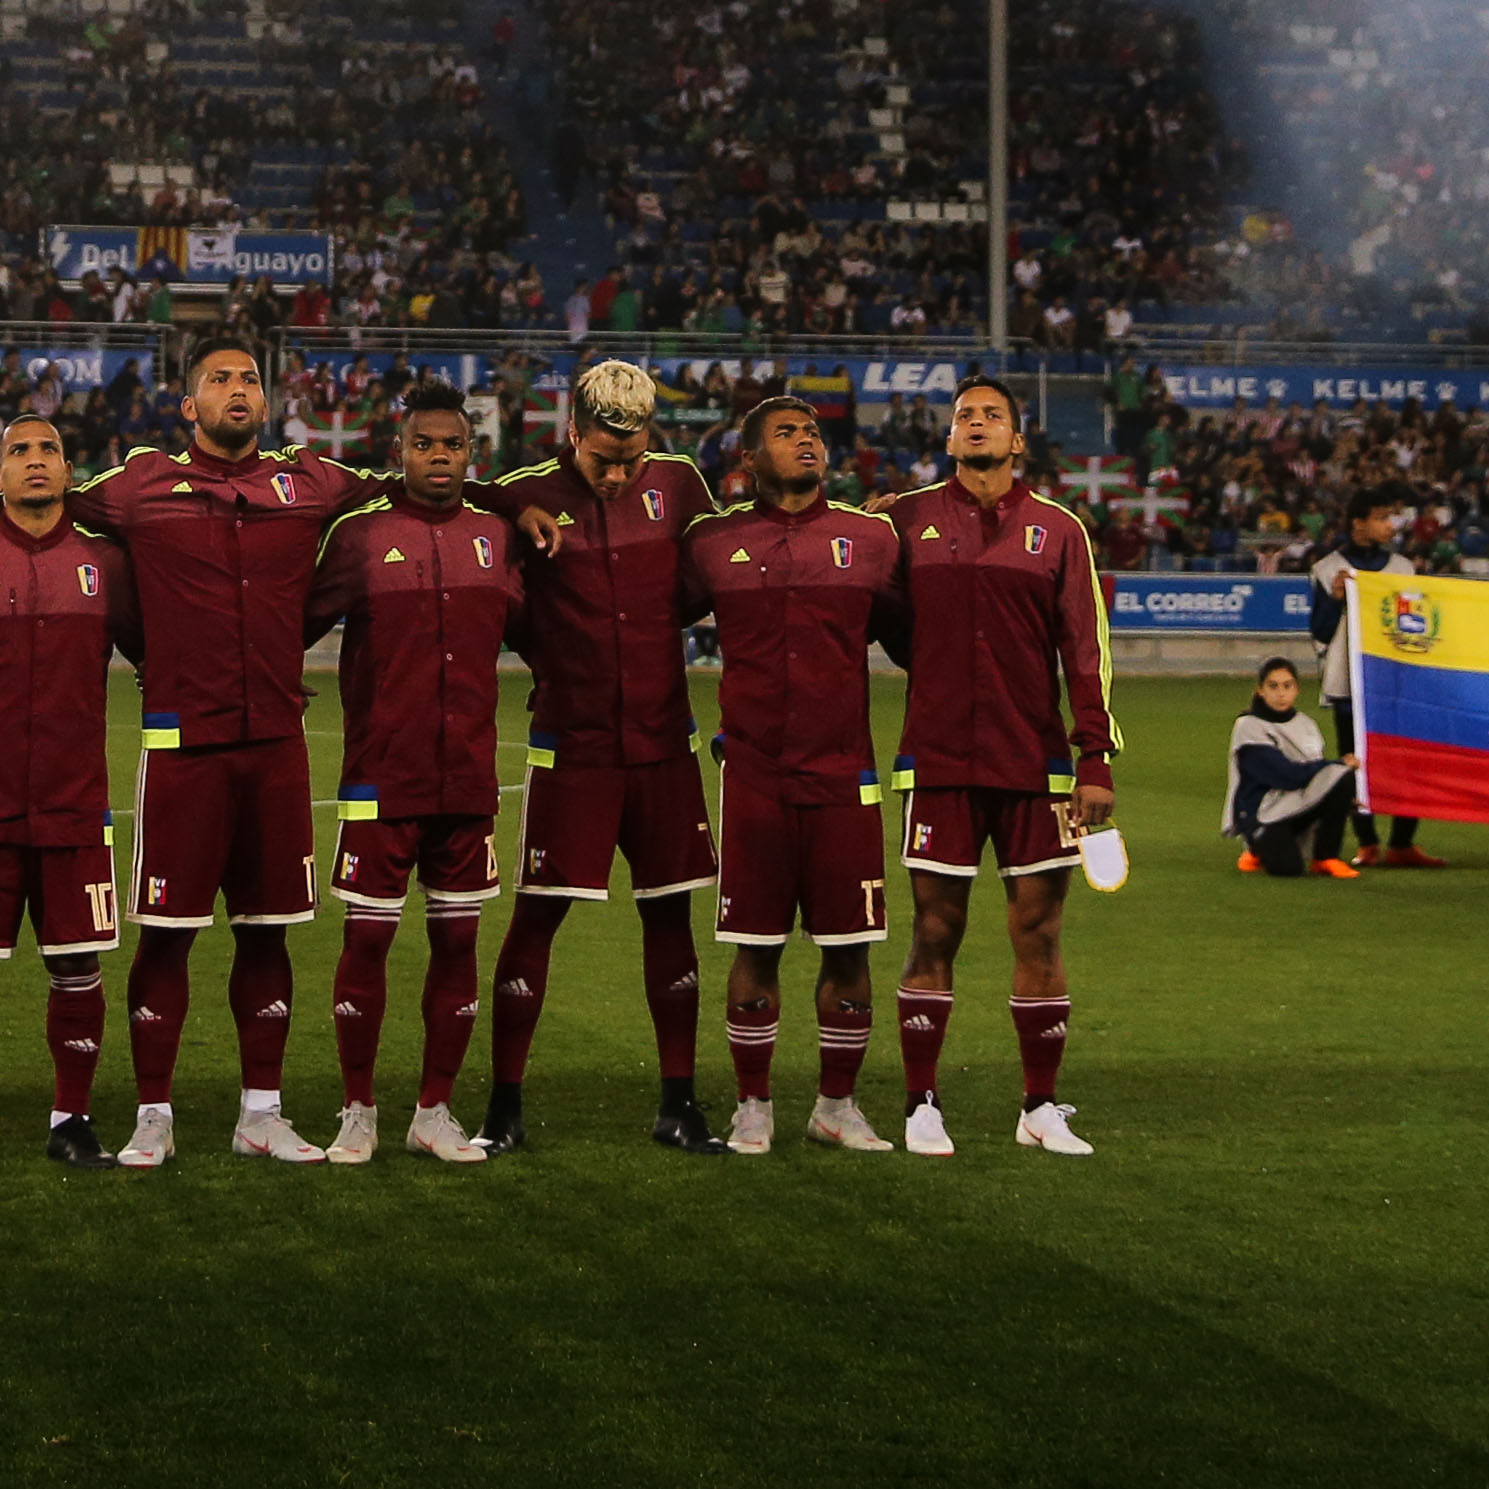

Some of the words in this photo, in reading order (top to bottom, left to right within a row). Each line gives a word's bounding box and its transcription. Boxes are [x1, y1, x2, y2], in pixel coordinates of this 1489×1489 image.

[81, 243, 129, 268] Del
[863, 362, 957, 391] LEA
[1164, 376, 1258, 399] ELME
[1312, 378, 1428, 401] KELME
[1115, 592, 1145, 613] EL
[1145, 592, 1246, 614] CORREO
